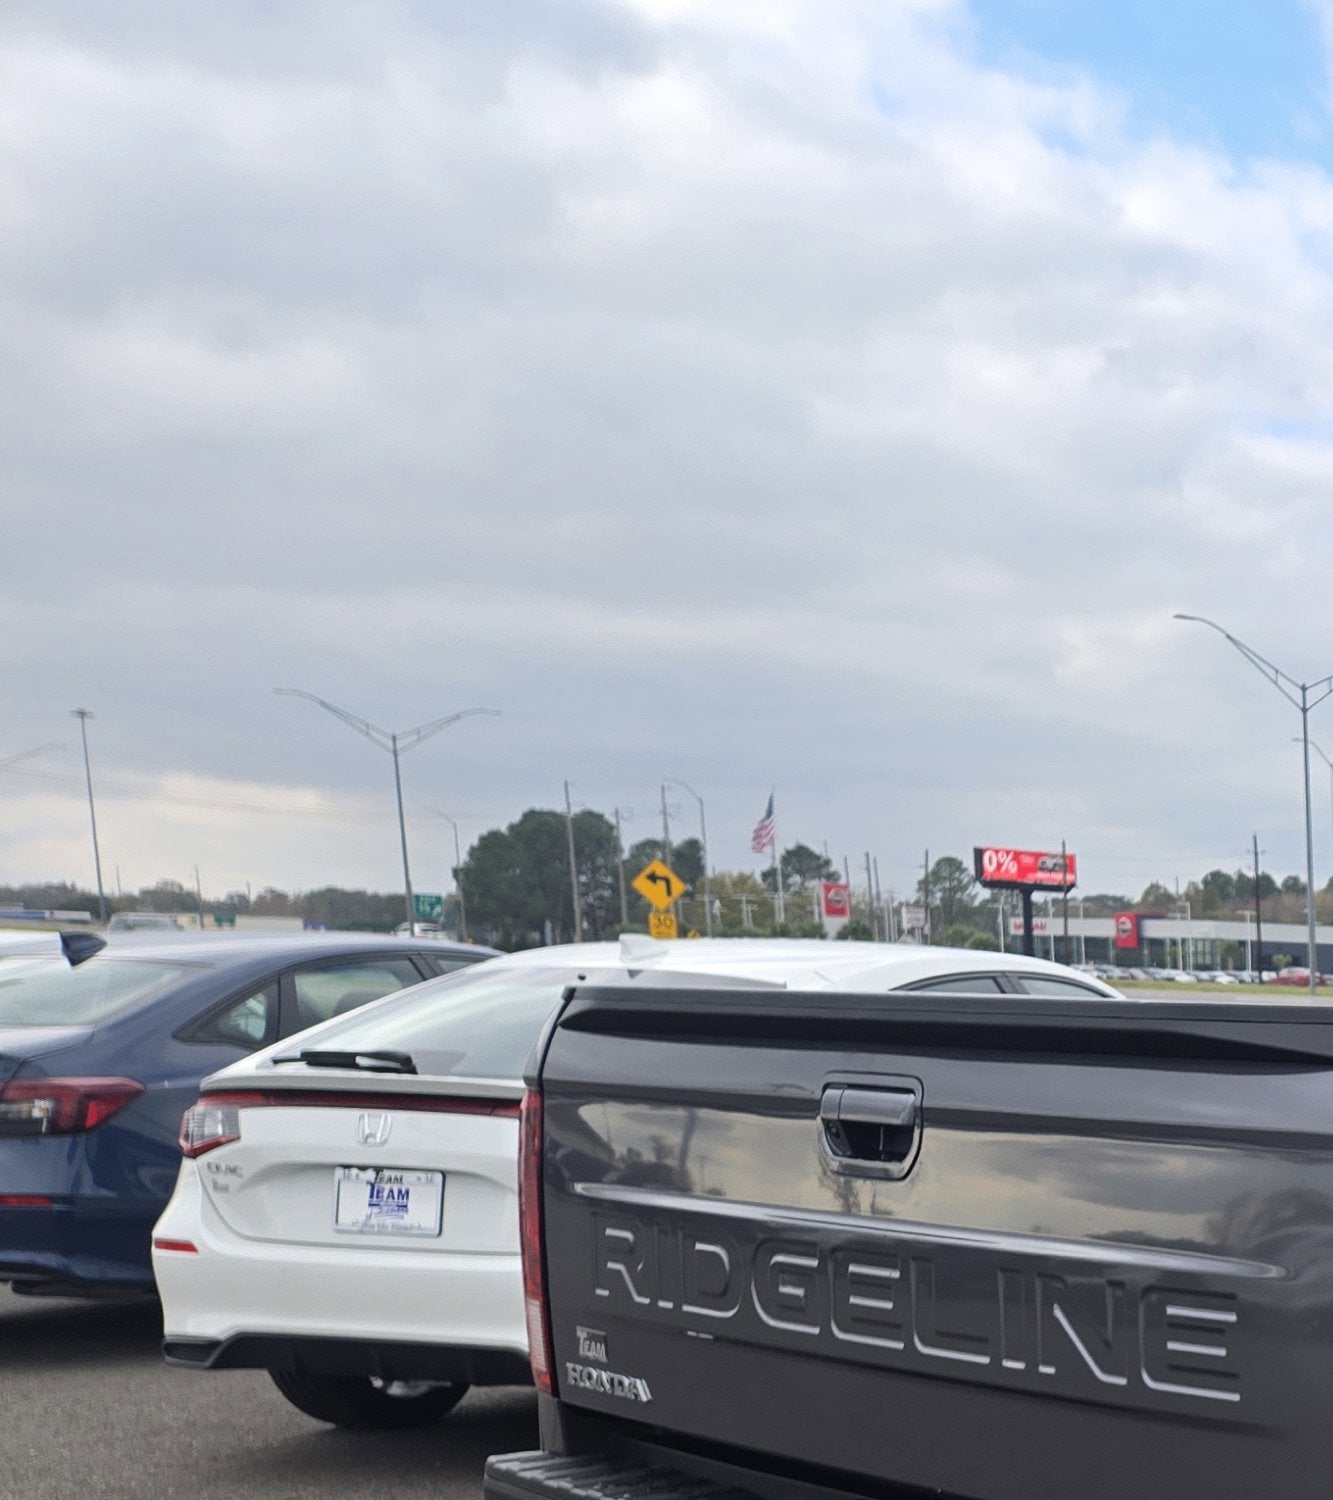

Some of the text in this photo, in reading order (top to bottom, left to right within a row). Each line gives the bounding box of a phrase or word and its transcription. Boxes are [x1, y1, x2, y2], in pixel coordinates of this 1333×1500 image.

[982, 849, 1018, 874] 0%
[366, 1181, 410, 1201] TEAM
[592, 1209, 1241, 1402] RIDGELINE
[576, 1326, 608, 1363] TEAM
[565, 1362, 653, 1403] HONDA
